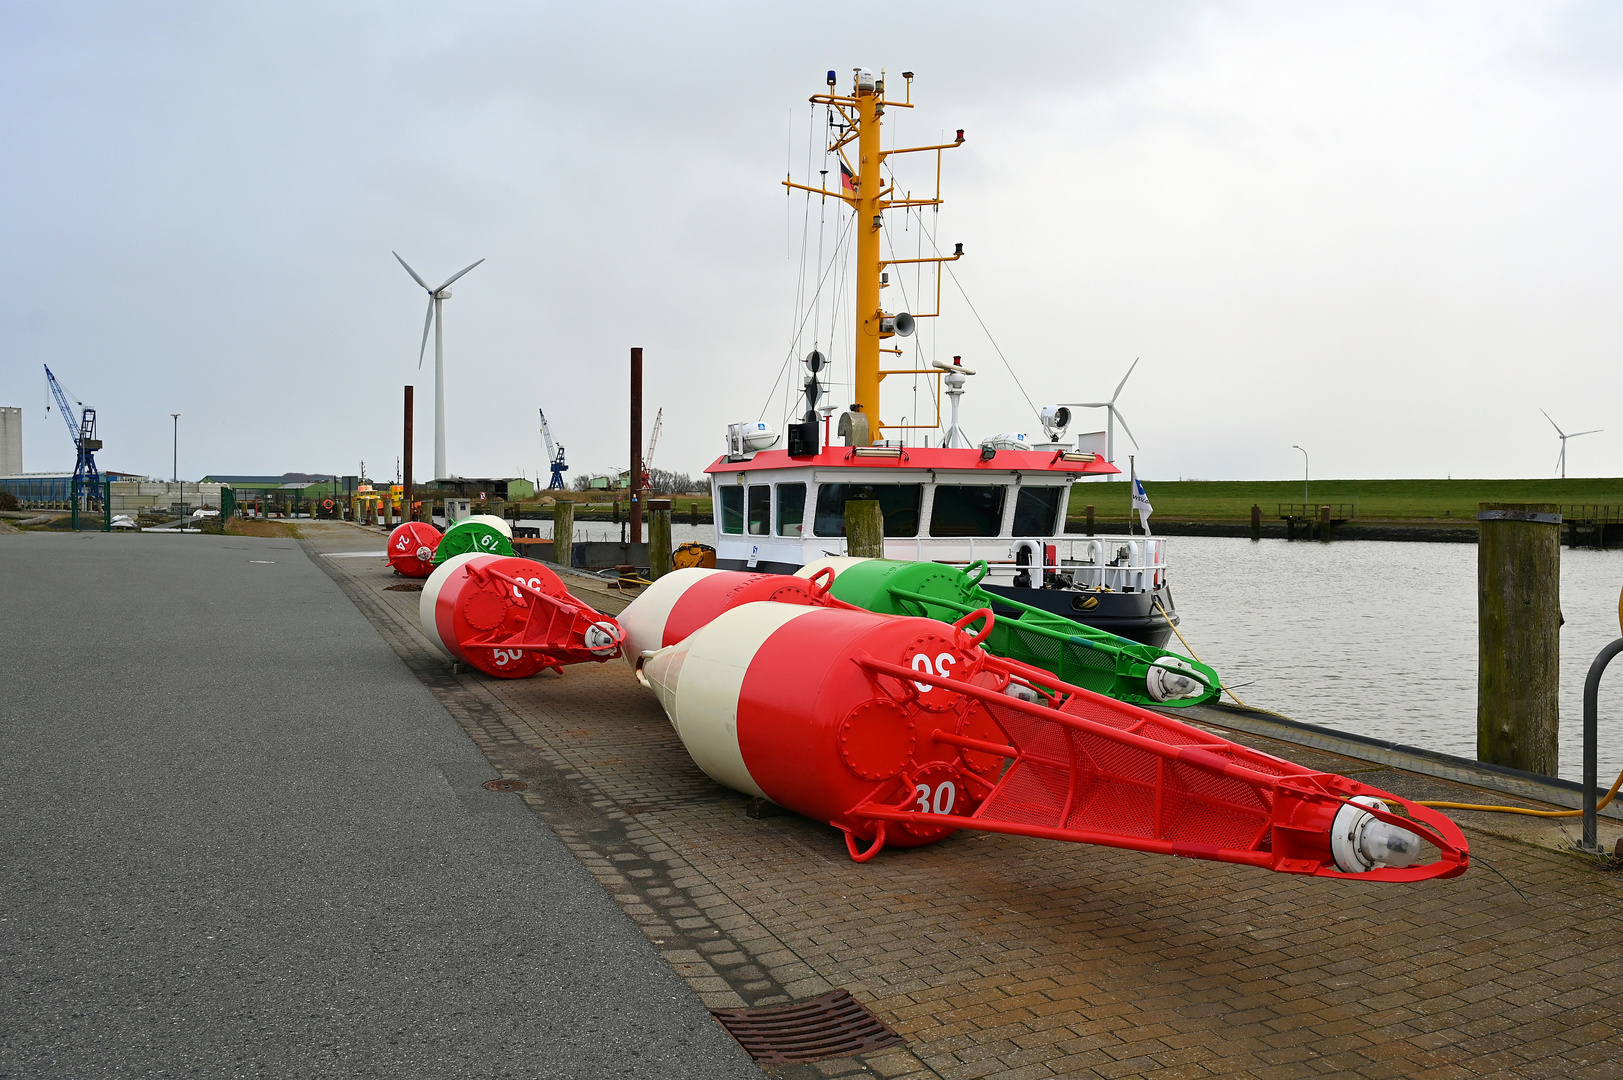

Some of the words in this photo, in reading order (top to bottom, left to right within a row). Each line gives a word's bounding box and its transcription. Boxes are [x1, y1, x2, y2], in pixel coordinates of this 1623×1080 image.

[395, 534, 410, 551] 24
[481, 534, 499, 551] 19
[493, 648, 523, 666] 50
[911, 652, 957, 693] 30
[908, 780, 956, 815] 30
